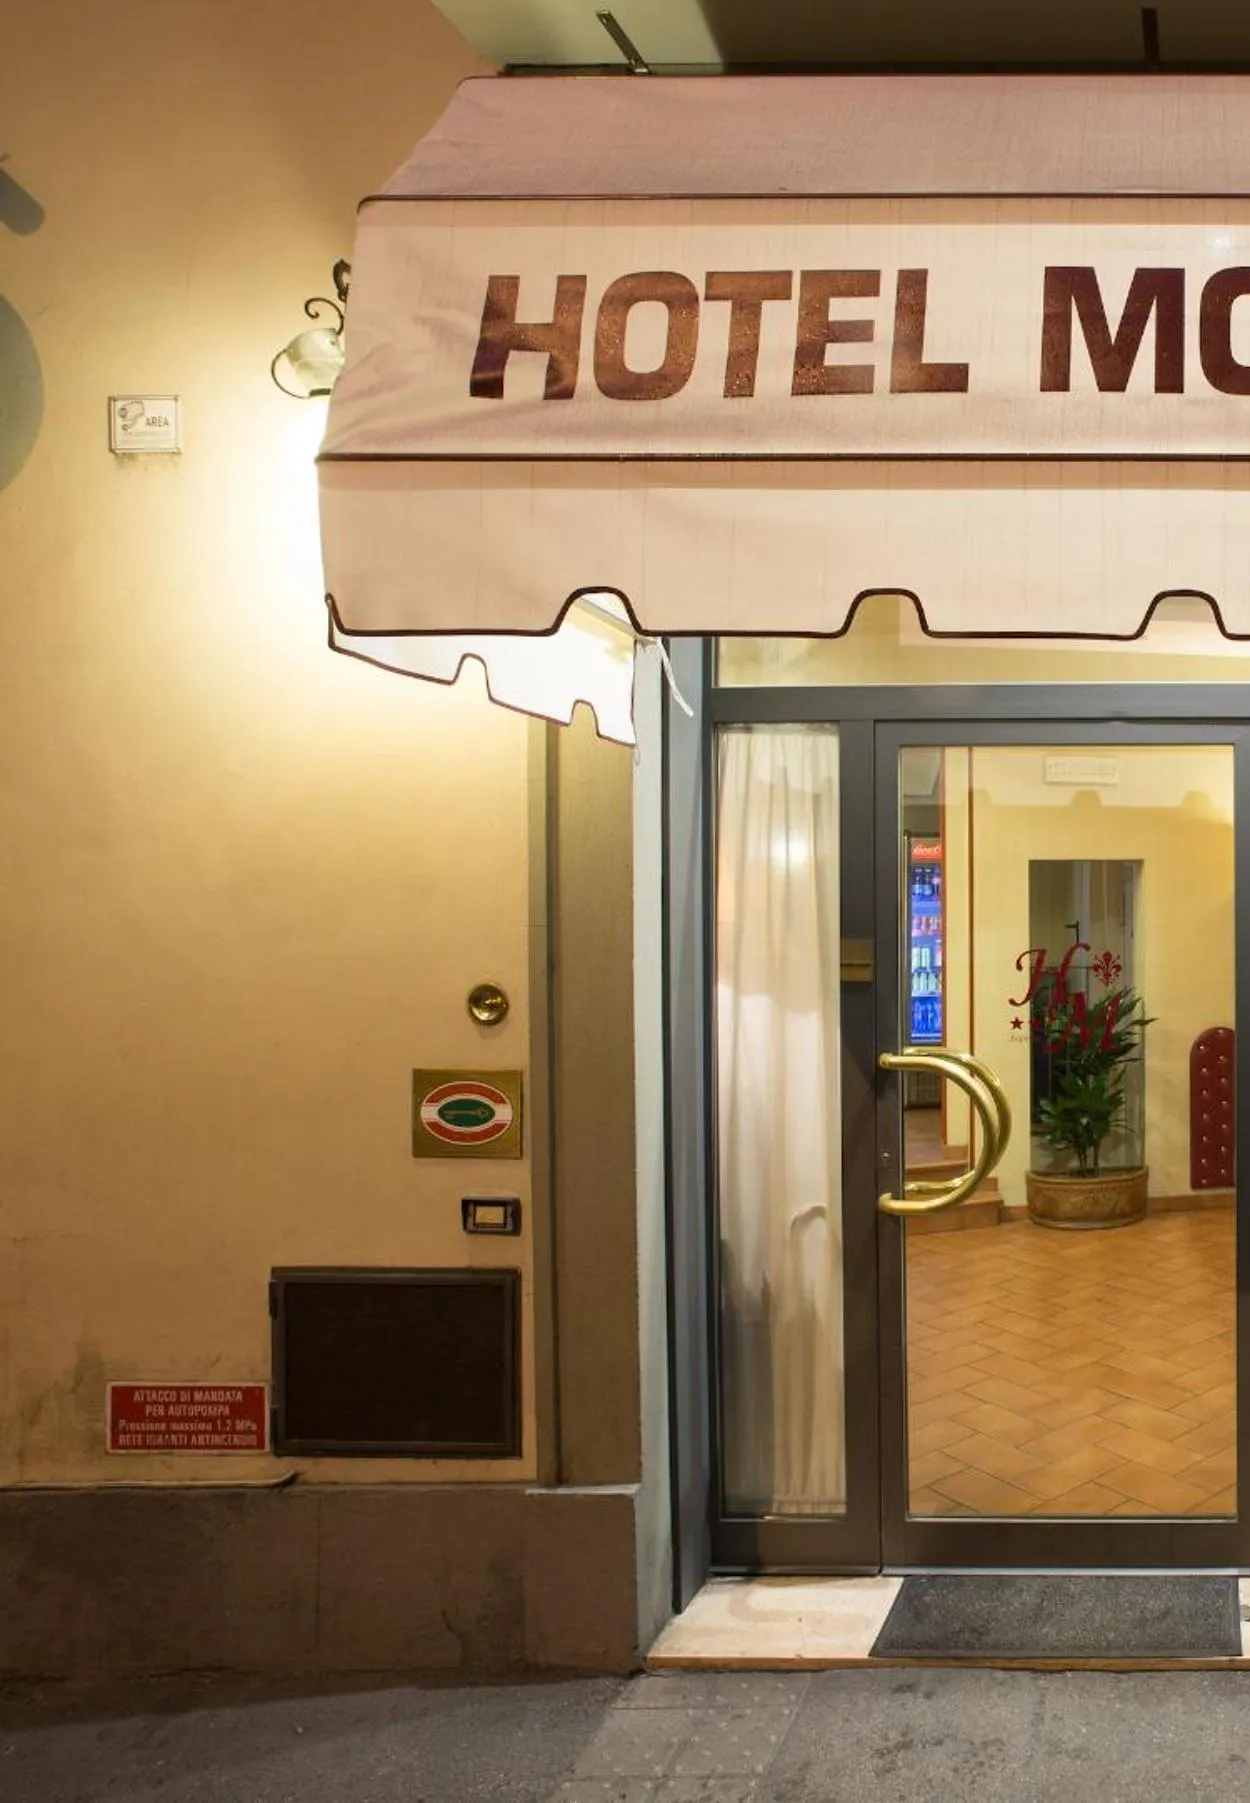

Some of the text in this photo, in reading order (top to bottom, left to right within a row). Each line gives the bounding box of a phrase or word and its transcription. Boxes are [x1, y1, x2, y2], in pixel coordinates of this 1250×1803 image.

[469, 268, 969, 401] HOTEL
[145, 416, 169, 427] AREA
[133, 1389, 243, 1403] ATTACCO DI MANDATA
[145, 1404, 230, 1417] PER AUTOPOMPA
[118, 1419, 167, 1431] Pressione
[169, 1419, 213, 1431] massima
[235, 1419, 258, 1431] MPa
